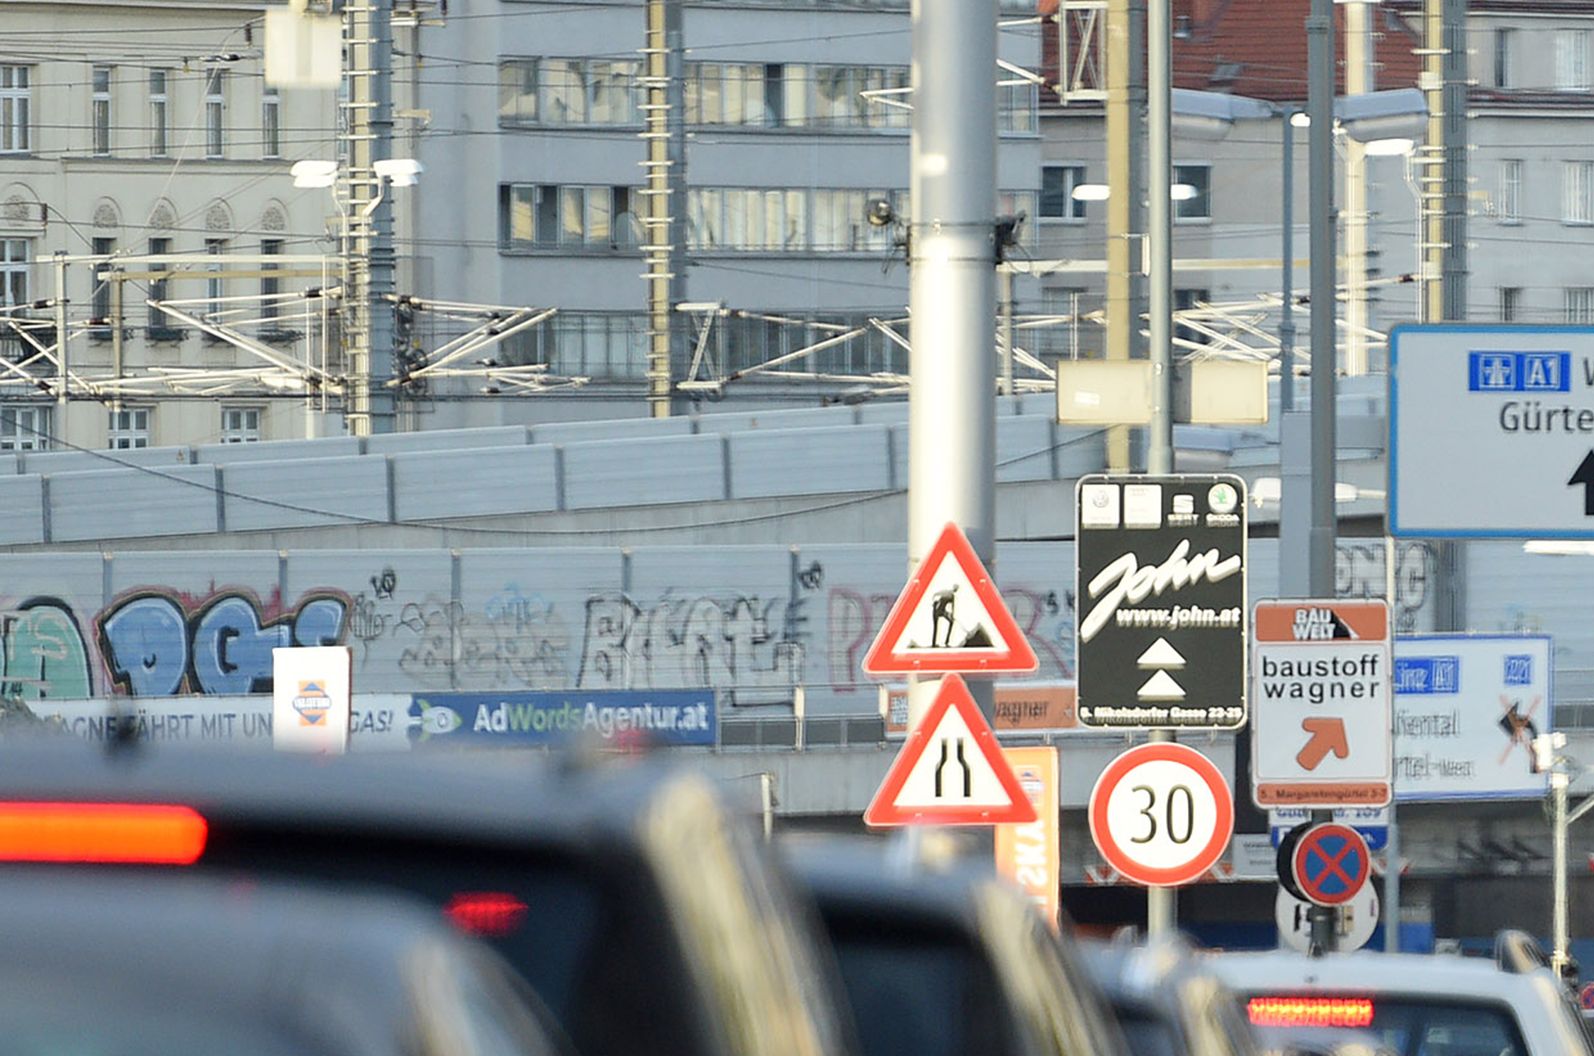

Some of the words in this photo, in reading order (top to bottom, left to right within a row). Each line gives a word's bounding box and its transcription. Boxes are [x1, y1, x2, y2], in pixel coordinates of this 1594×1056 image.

[1529, 358, 1558, 380] A1
[1080, 539, 1241, 640] John
[1116, 605, 1241, 627] www.john.at
[1296, 608, 1332, 624] BAU
[1292, 623, 1336, 640] WELT
[1263, 654, 1379, 677] baustoff
[1264, 682, 1380, 704] wagner
[201, 713, 237, 739] MIT
[473, 702, 709, 737] AdWordsAgentur.at
[1130, 784, 1194, 844] 30
